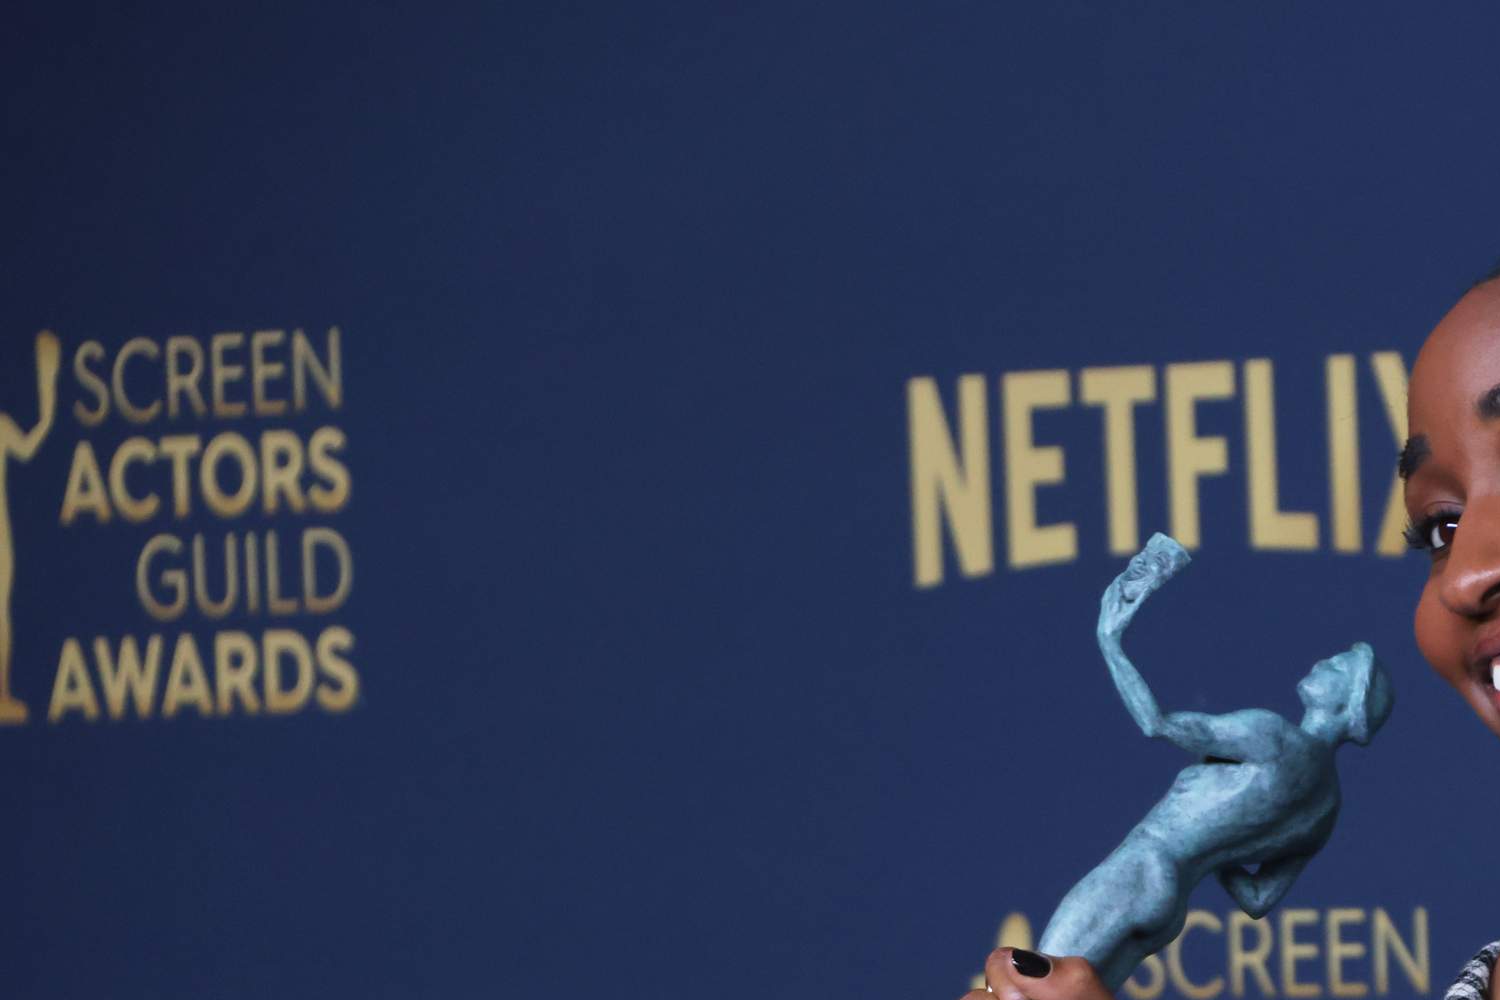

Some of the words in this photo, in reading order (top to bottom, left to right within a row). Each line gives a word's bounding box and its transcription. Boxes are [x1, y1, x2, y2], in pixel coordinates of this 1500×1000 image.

[72, 326, 345, 427] SCREEN
[60, 427, 352, 525] ACTORS
[135, 527, 353, 620] GUILD
[48, 626, 361, 722] AWARDS
